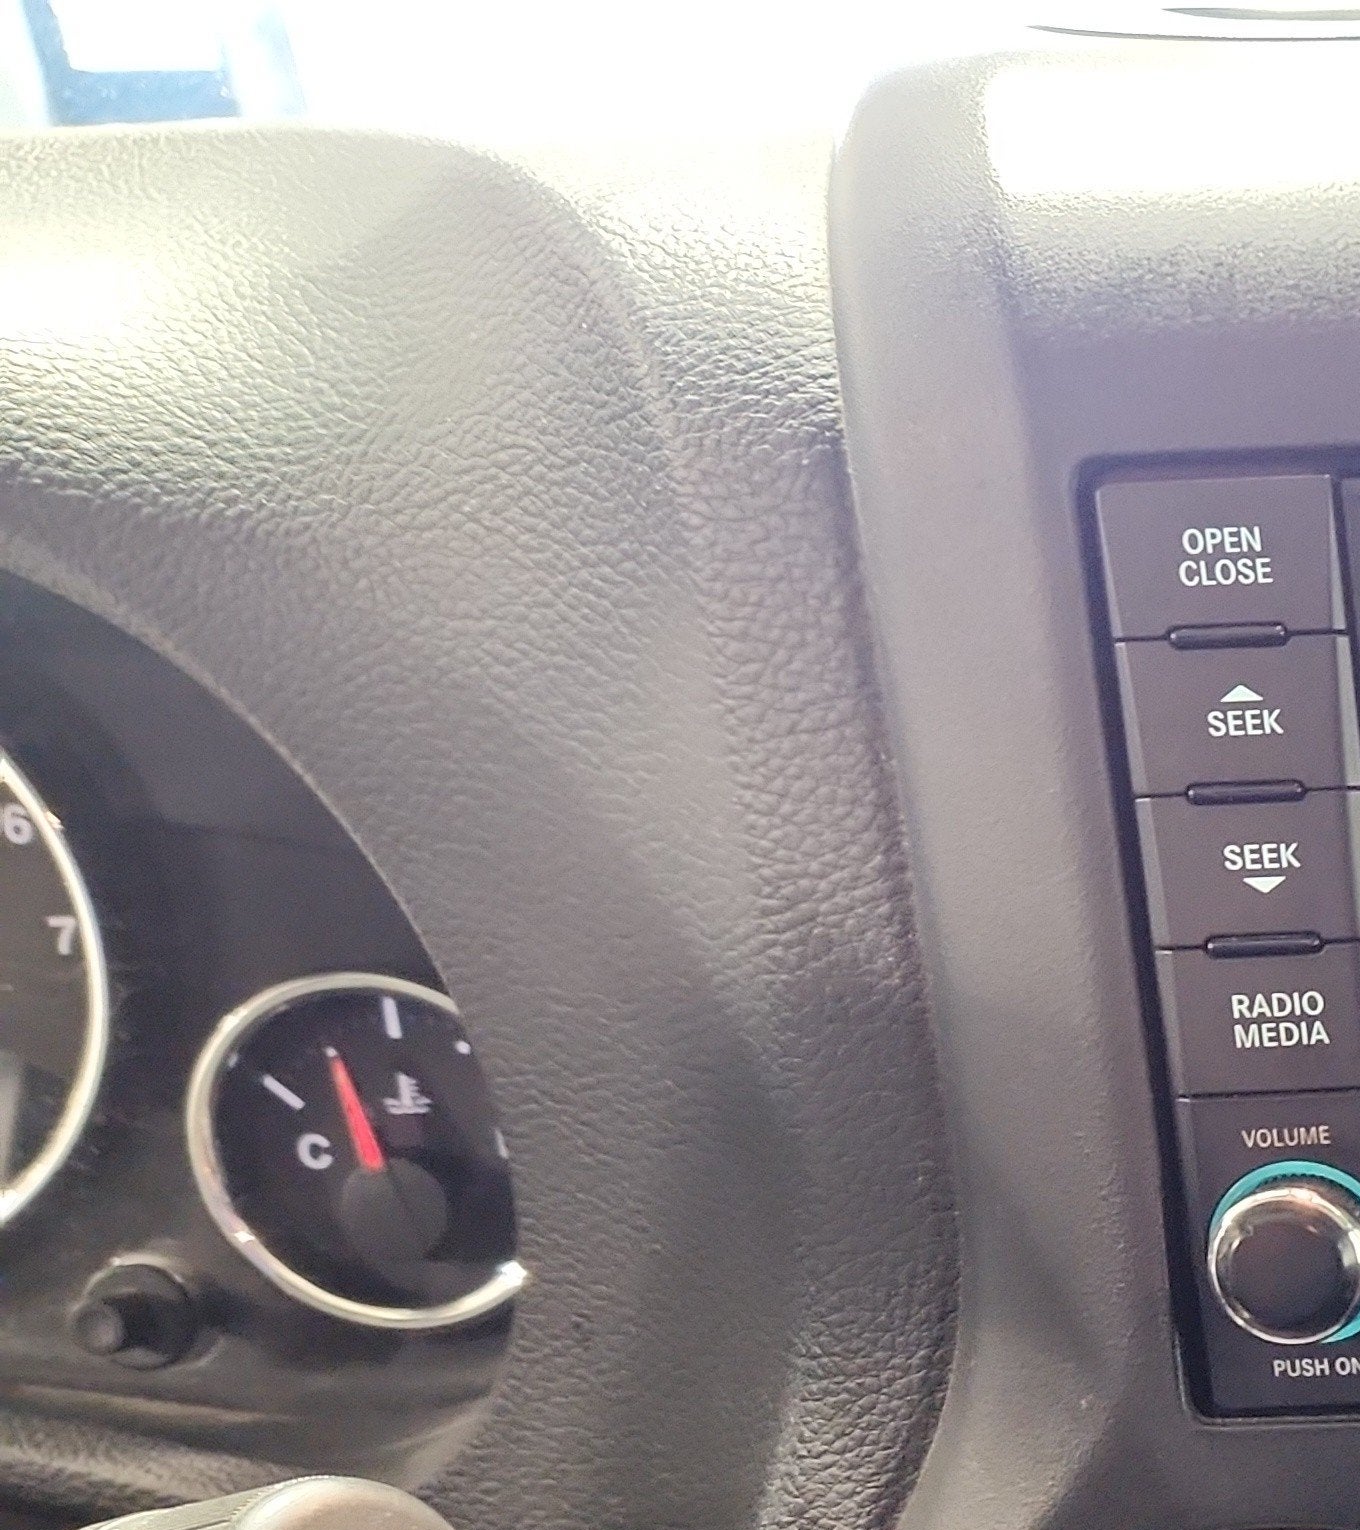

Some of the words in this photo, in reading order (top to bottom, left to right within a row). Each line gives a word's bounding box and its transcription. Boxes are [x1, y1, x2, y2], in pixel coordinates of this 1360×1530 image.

[1181, 525, 1262, 555] OPEN
[1178, 557, 1274, 587] CLOSE
[1206, 708, 1284, 737] SEEK
[0, 805, 33, 846] 6
[1222, 842, 1301, 871] SEEK
[45, 914, 77, 957] 7
[1230, 990, 1325, 1020] RADIO
[1233, 1020, 1331, 1049] MEDIA
[1241, 1124, 1332, 1149] VOLUME
[298, 1132, 334, 1172] C
[1272, 1356, 1331, 1379] PUSH
